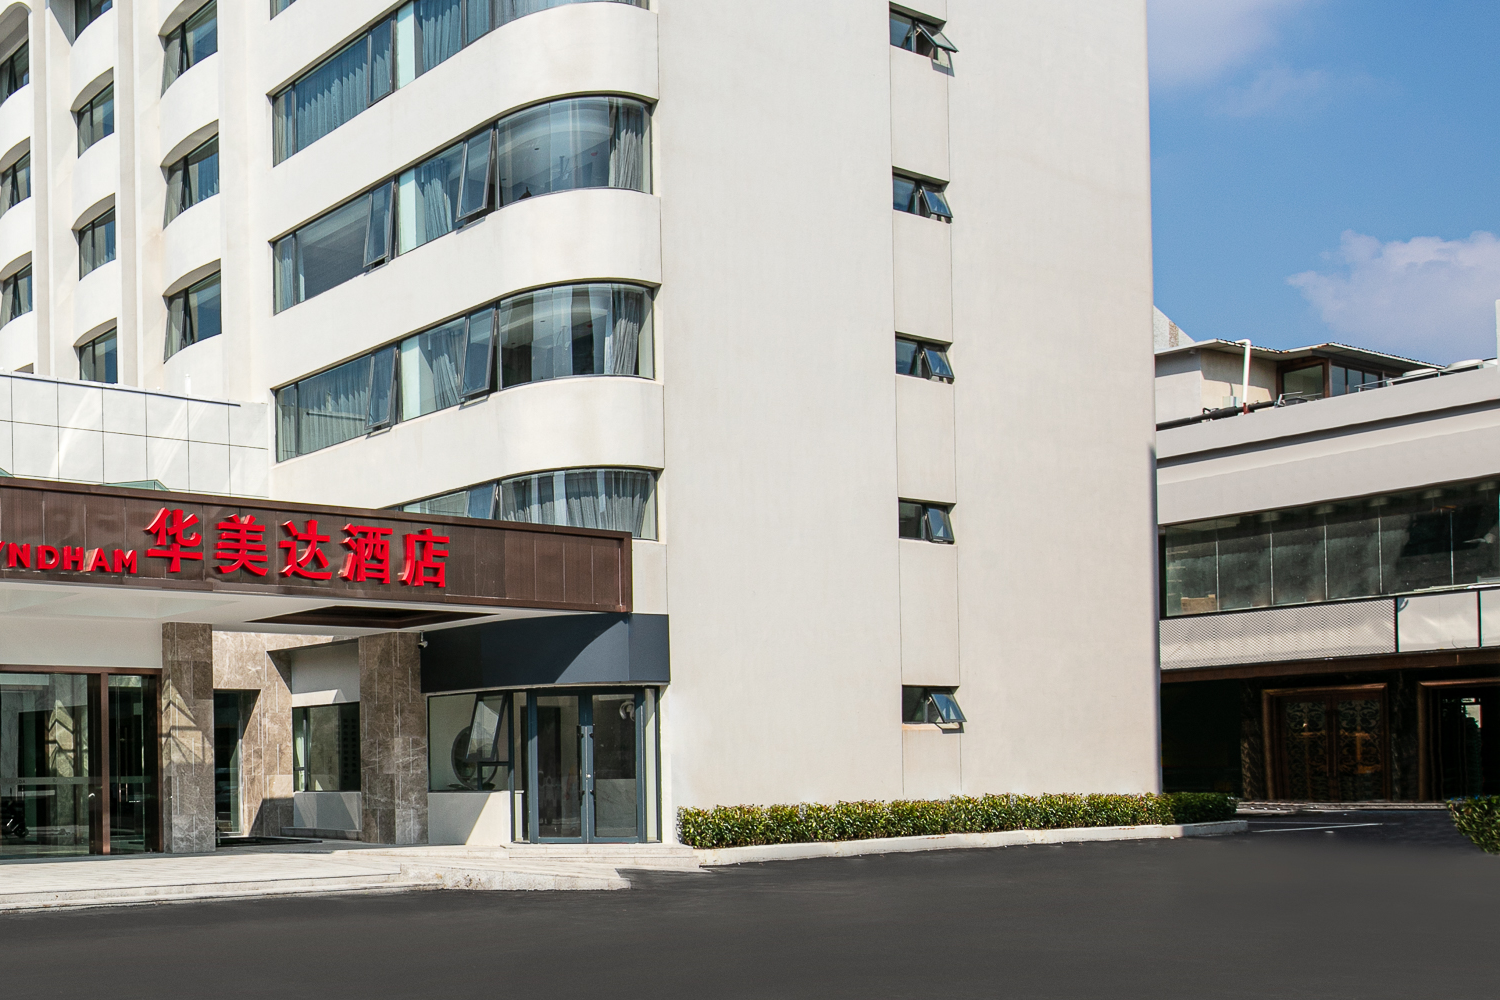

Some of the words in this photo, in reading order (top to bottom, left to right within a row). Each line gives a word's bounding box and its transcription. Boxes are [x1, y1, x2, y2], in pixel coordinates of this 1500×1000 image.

[144, 507, 450, 588] 华美达酒店
